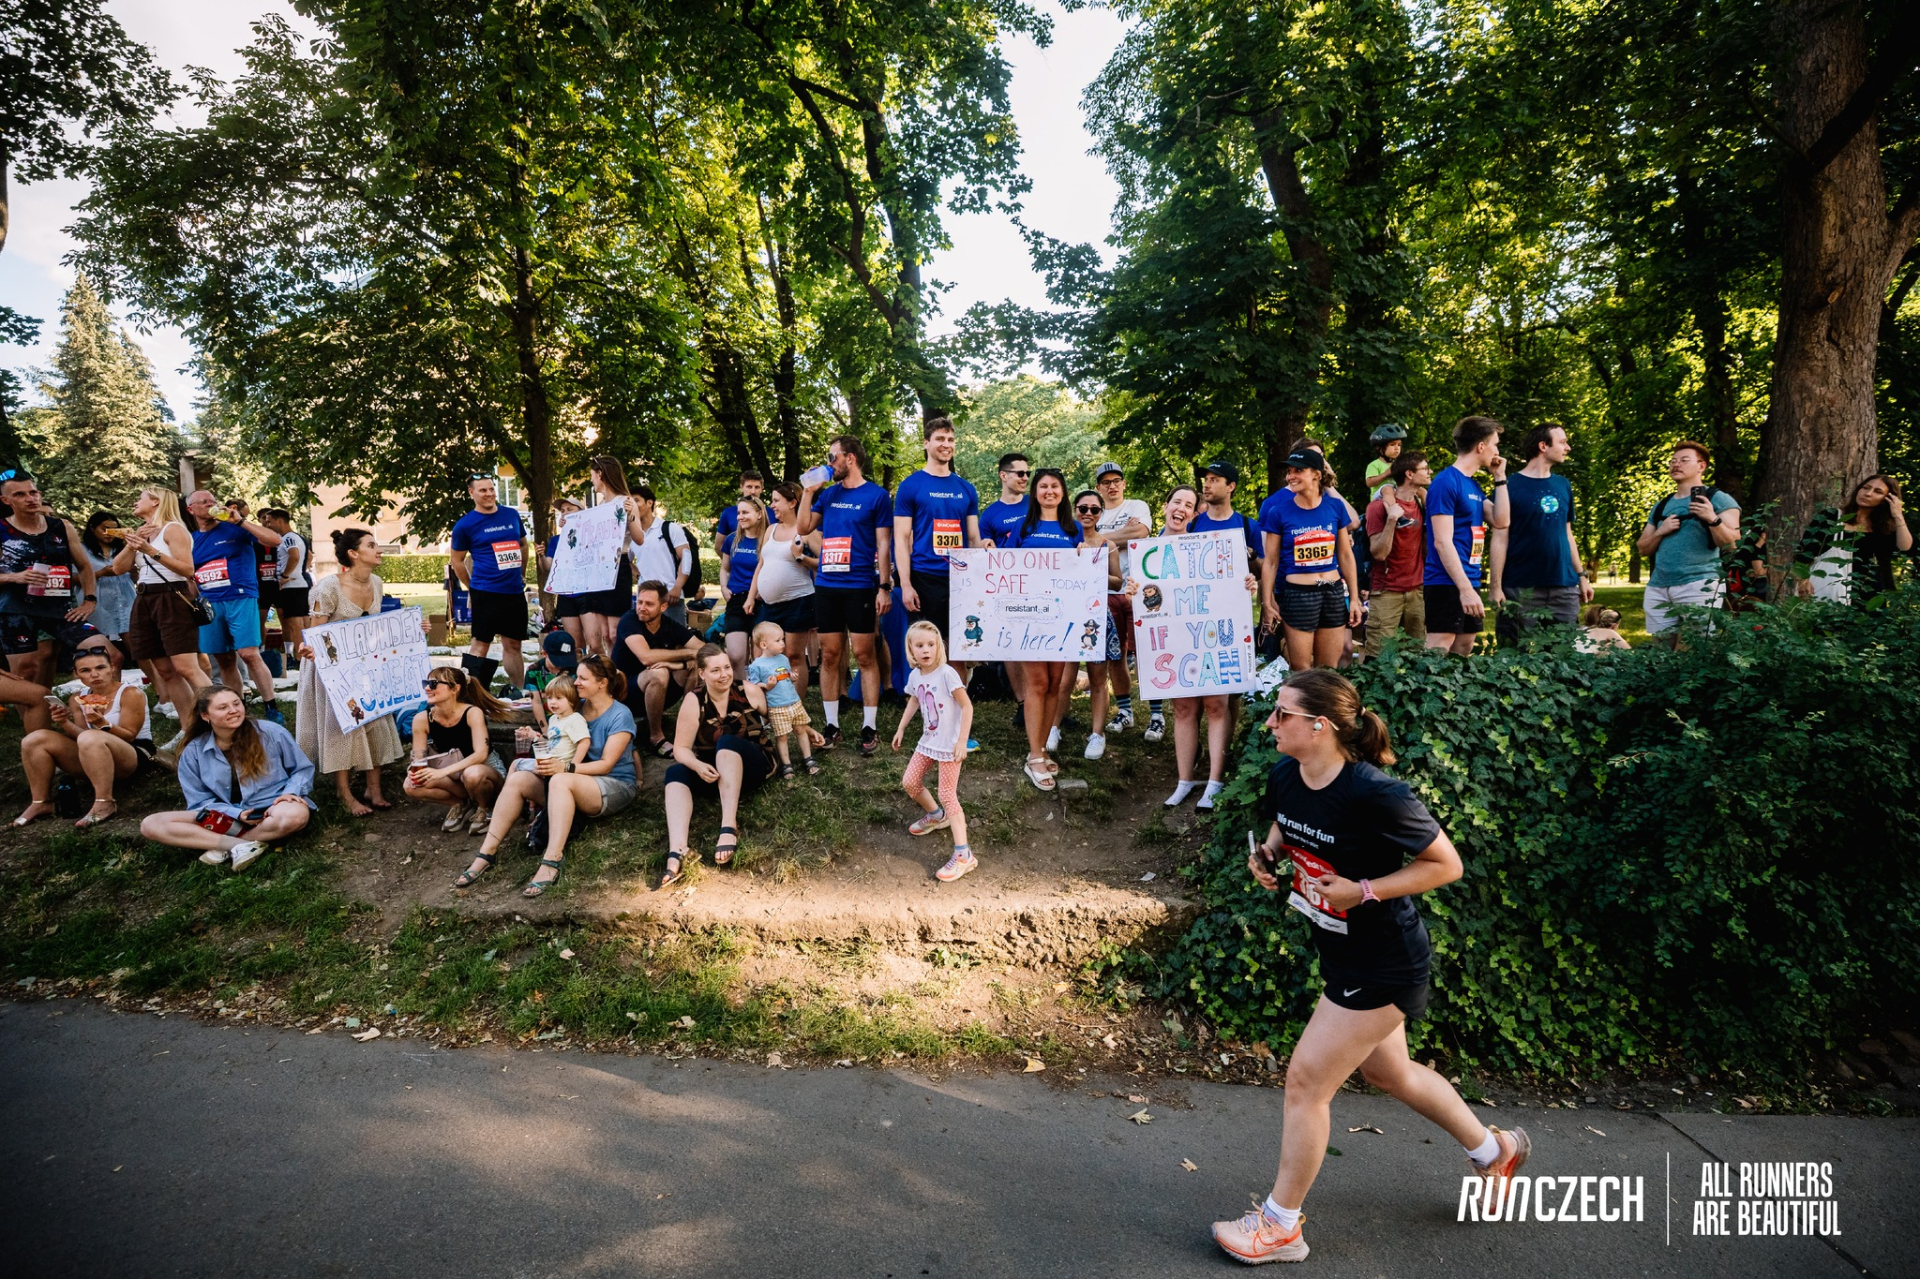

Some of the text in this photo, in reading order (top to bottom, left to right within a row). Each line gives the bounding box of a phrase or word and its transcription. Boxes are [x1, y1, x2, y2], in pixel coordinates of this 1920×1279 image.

[936, 535, 959, 546] 3370
[1297, 545, 1328, 560] 3365
[824, 552, 844, 563] 3317
[988, 551, 1061, 570] NO ONE
[1141, 539, 1234, 580] CATCH
[197, 571, 223, 583] 3592
[961, 573, 1088, 595] IS SAFE TODAY
[1173, 584, 1211, 616] ME
[340, 610, 426, 660] LAUNDER
[997, 626, 1013, 649] is
[1149, 618, 1235, 651] IF YOU
[1150, 648, 1242, 690] SCAN
[351, 652, 430, 712] SWEAT
[1287, 819, 1303, 831] run
[1303, 823, 1316, 837] for
[1316, 829, 1335, 844] fun
